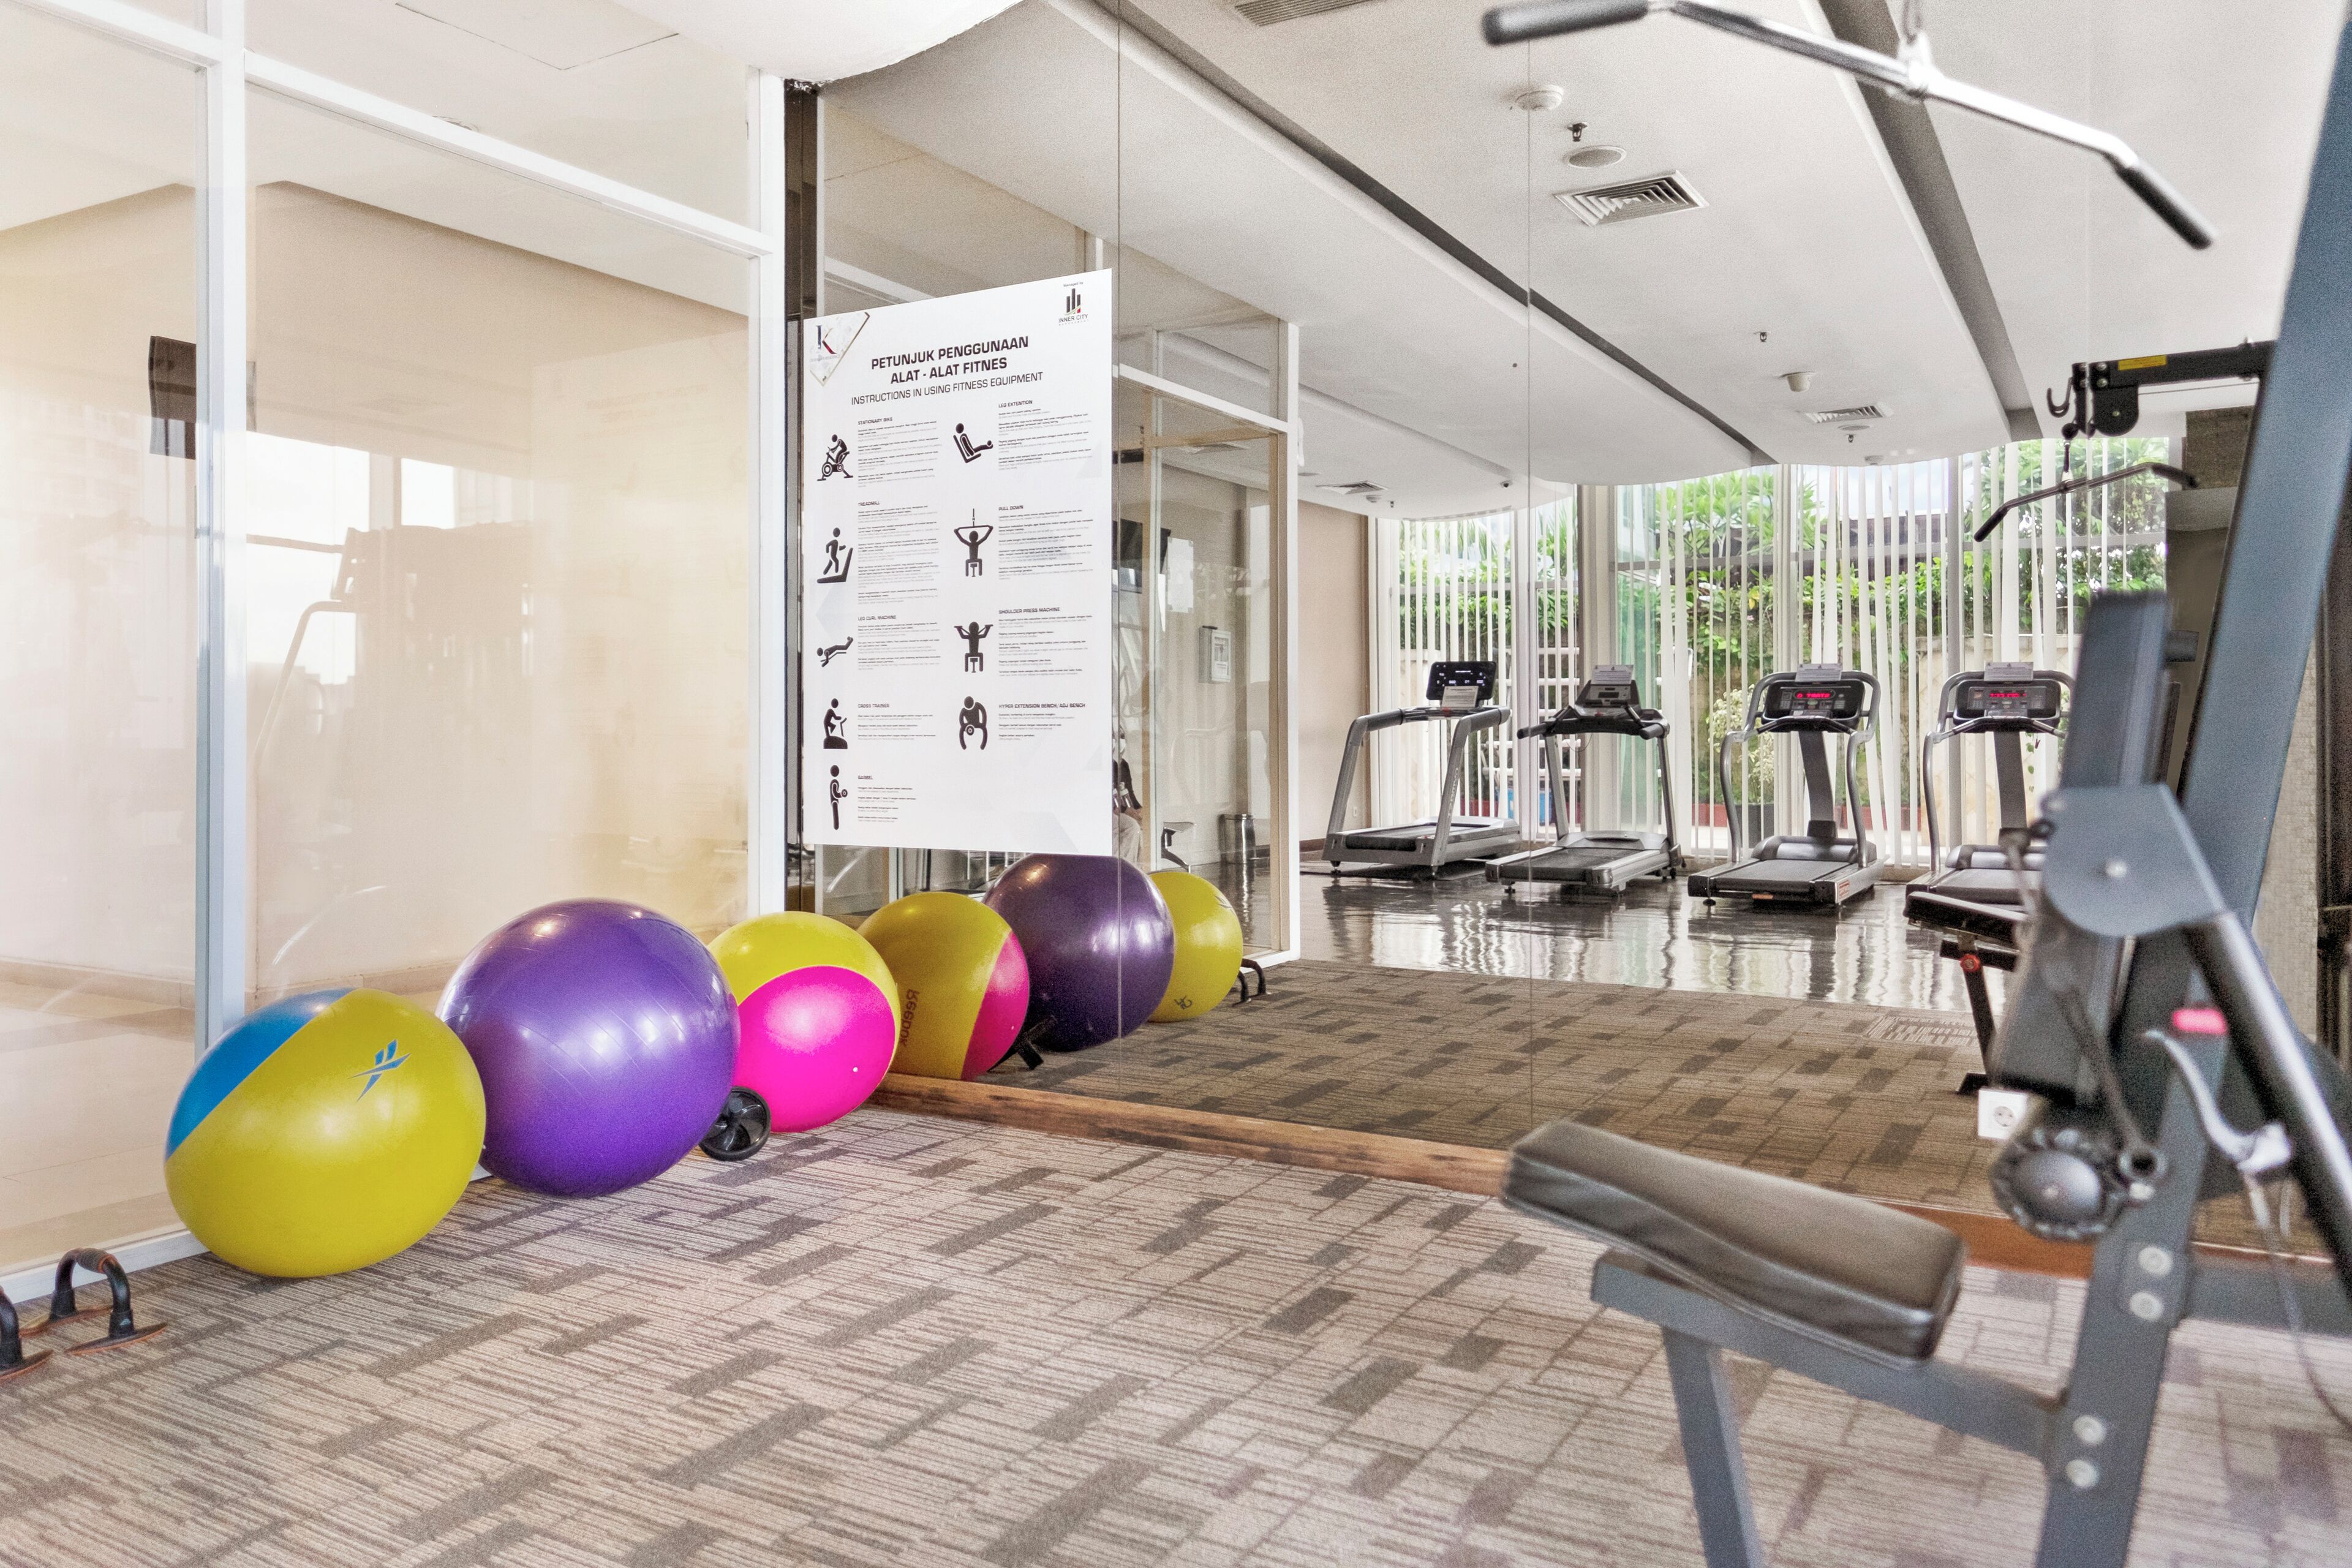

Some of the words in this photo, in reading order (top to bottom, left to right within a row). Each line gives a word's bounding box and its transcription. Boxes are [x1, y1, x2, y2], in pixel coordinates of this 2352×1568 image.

[872, 350, 935, 369] PETUNJUK
[938, 336, 1028, 360] PENGGUNAAN
[891, 369, 920, 384] ALAT
[929, 363, 960, 379] ALAT
[963, 357, 1008, 374] FITNES
[851, 390, 911, 405] INSTRUCTIONS
[913, 388, 922, 397] IN
[924, 384, 951, 396] USING
[953, 379, 988, 392] FITNESS
[990, 372, 1043, 387] EQUIPMENT
